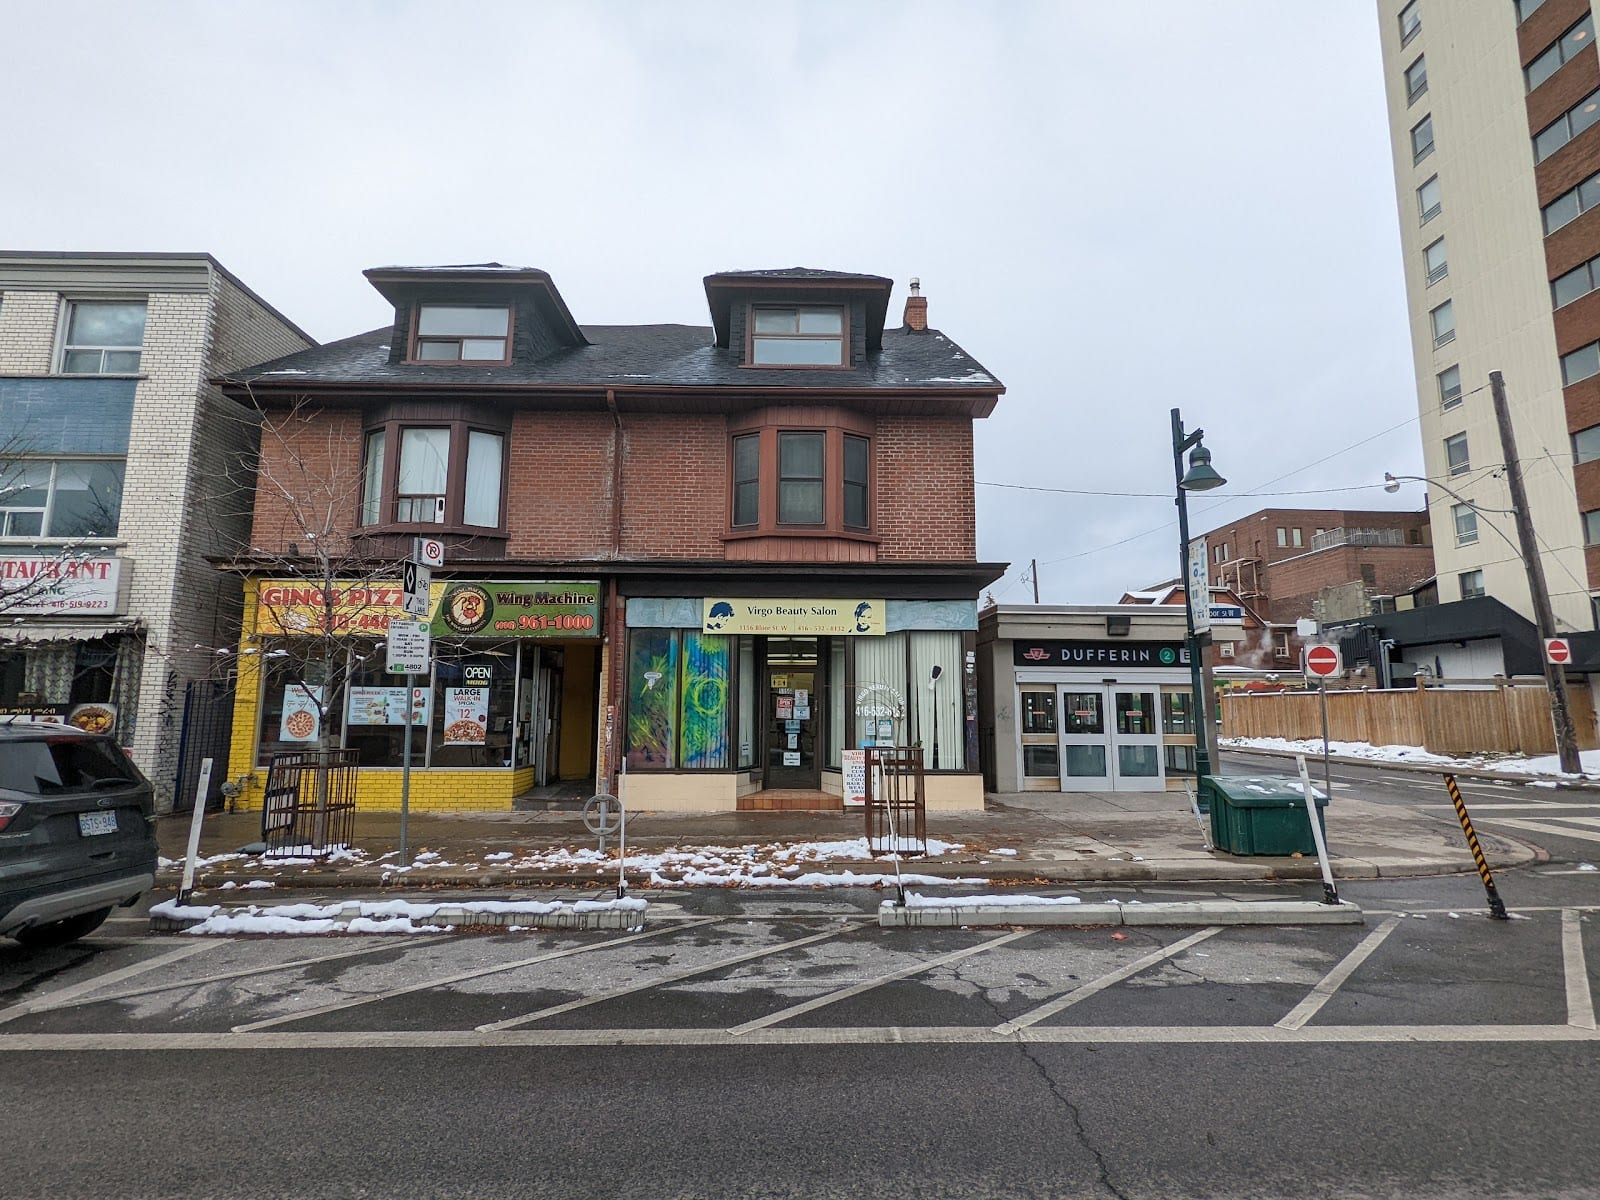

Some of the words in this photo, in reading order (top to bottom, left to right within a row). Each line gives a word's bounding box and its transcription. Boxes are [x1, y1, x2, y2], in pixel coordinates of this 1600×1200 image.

[347, 588, 404, 606] PIZZ
[496, 591, 533, 608] Wing
[534, 591, 595, 606] Machine
[747, 606, 773, 617] Virgo
[776, 606, 808, 617] Beauty
[811, 606, 838, 616] Salon
[318, 614, 400, 630] 310-446
[518, 614, 594, 630] 961-1000
[1061, 648, 1150, 661] DUFFERIN
[465, 666, 491, 679] OPEN
[453, 688, 481, 696] LARGE
